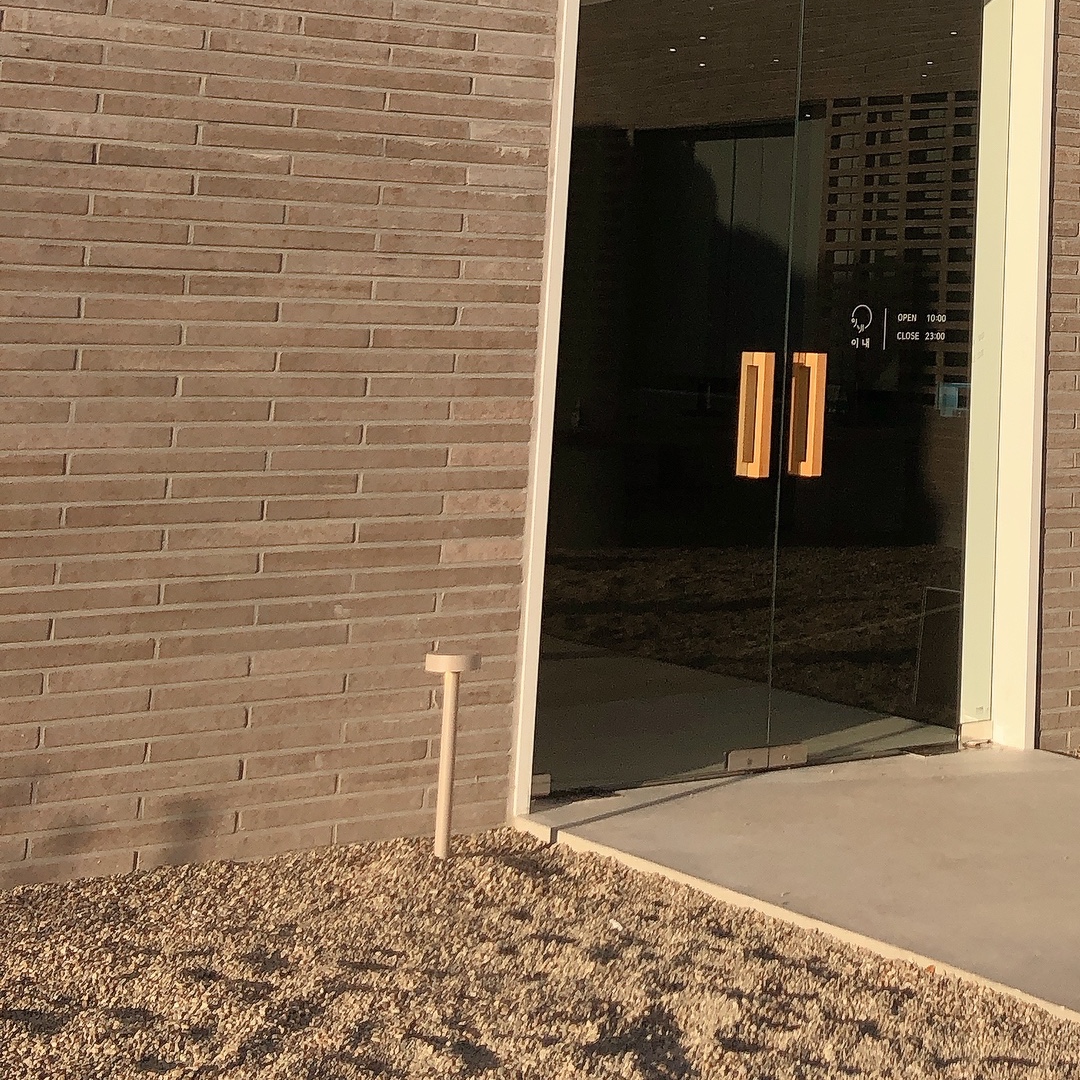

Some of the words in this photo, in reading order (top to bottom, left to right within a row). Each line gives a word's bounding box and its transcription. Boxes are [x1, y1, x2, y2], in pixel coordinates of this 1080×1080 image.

[897, 313, 917, 322] OPEN
[926, 313, 947, 323] 10:00
[896, 331, 920, 341] CLOSE
[924, 331, 946, 341] 23:00
